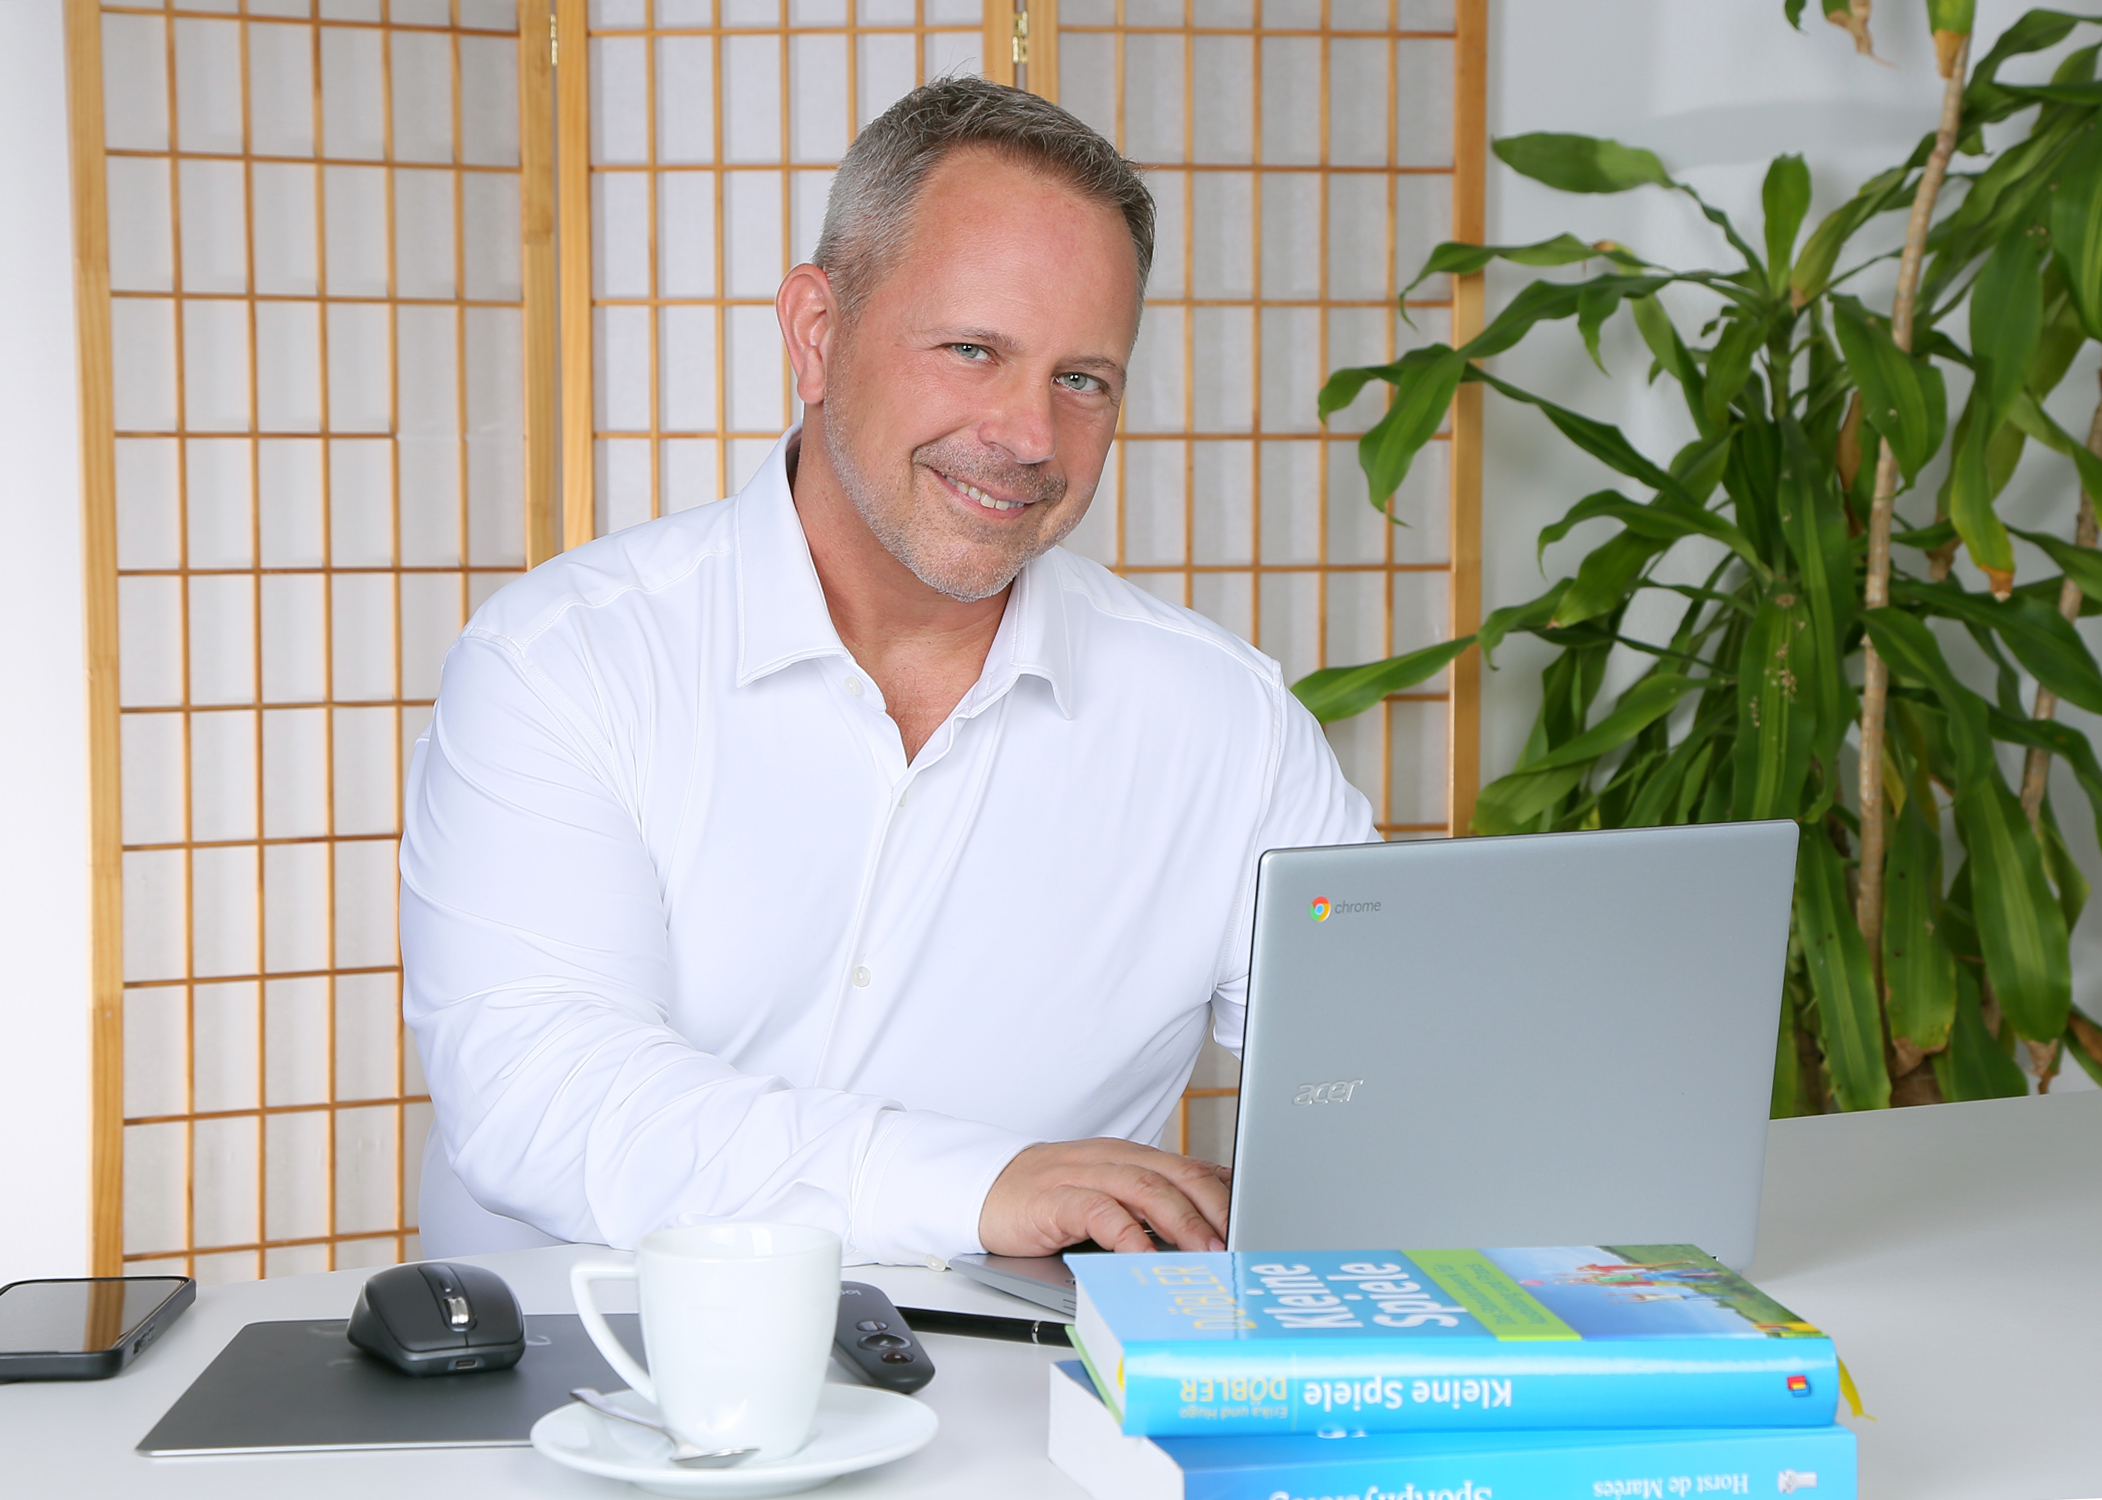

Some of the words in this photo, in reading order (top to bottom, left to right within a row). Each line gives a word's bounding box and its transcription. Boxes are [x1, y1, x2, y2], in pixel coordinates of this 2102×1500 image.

[1334, 899, 1382, 915] chrome
[1292, 1078, 1365, 1106] acer
[1151, 1264, 1258, 1330] DÖBLER
[1245, 1263, 1364, 1330] Kleine
[1325, 1262, 1469, 1330] Spiele
[1179, 1377, 1288, 1405] DÖBLER
[1303, 1374, 1404, 1412] Spiele
[1411, 1377, 1513, 1409] Kleine
[1179, 1406, 1218, 1420] Hugo
[1220, 1407, 1249, 1420] und
[1252, 1406, 1288, 1419] Erika
[1592, 1478, 1664, 1500] Marées
[1668, 1475, 1692, 1498] de
[1697, 1472, 1749, 1495] Horst
